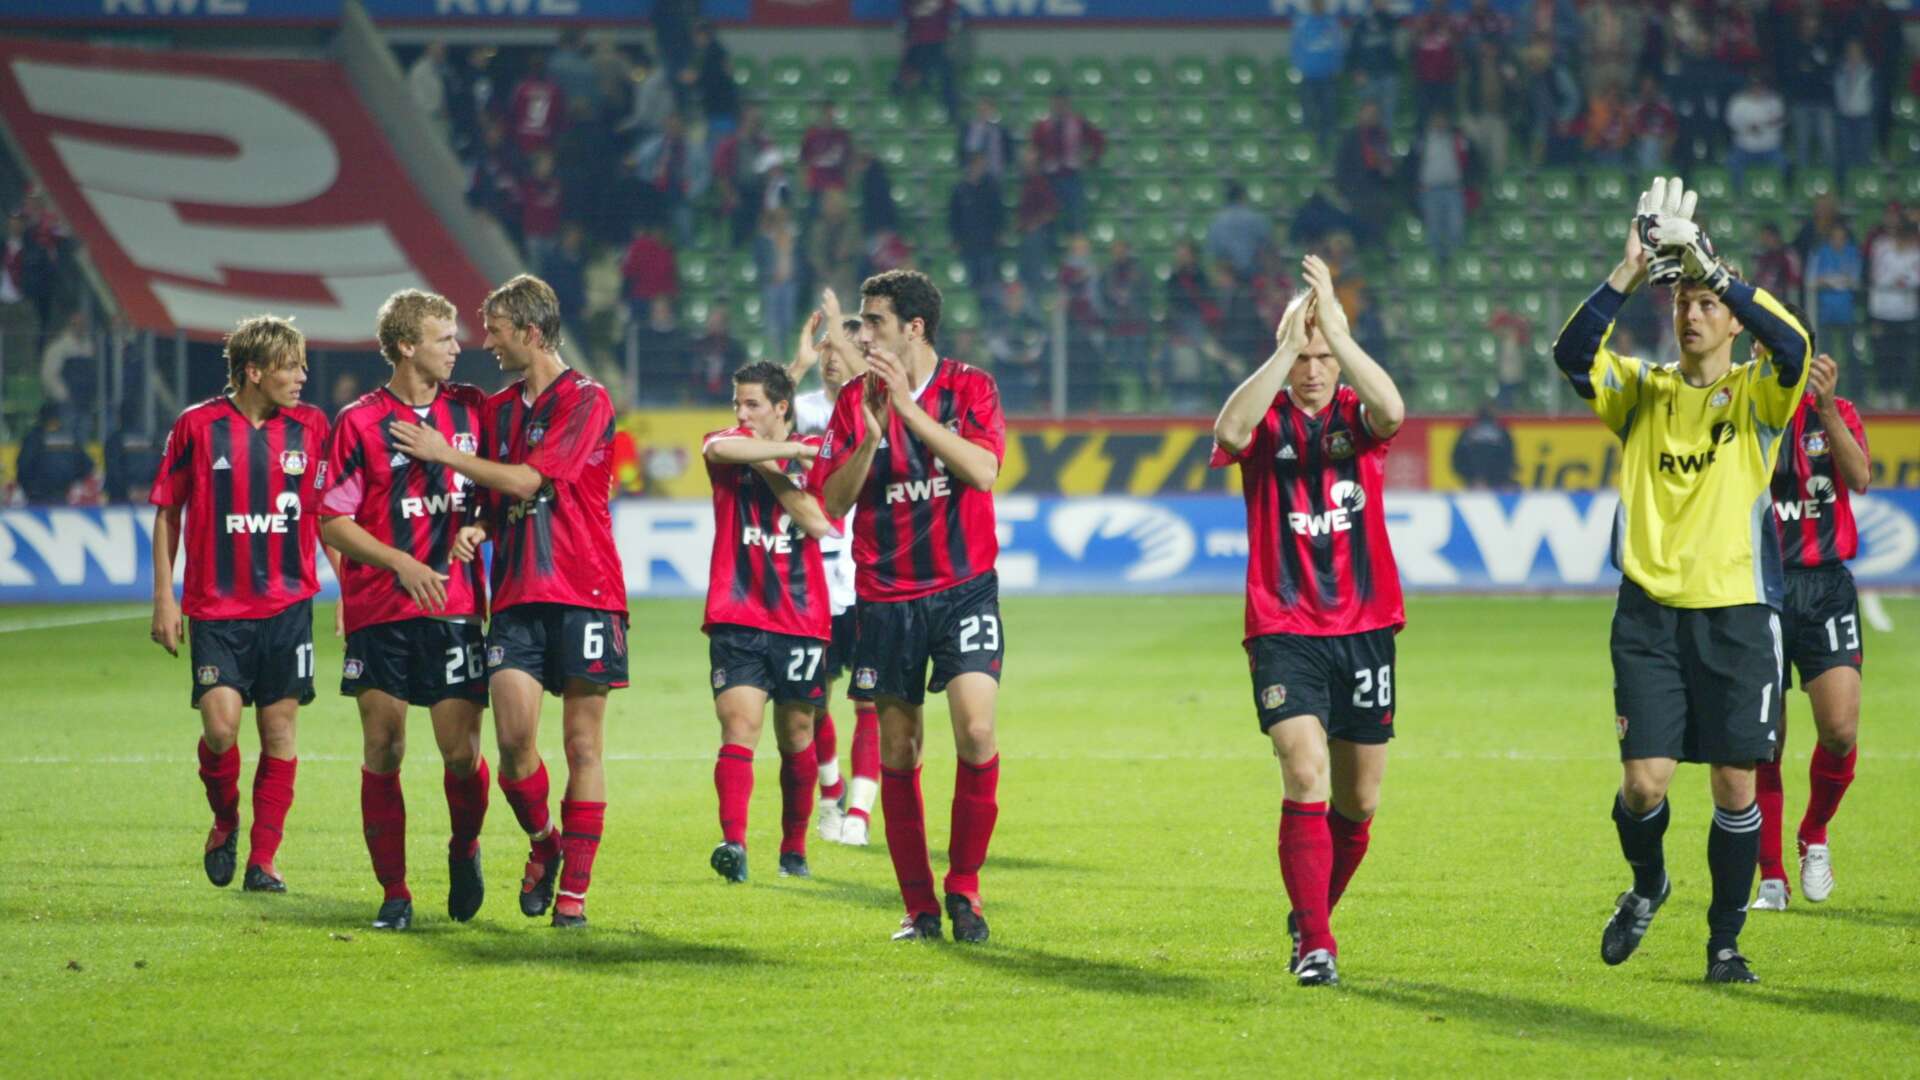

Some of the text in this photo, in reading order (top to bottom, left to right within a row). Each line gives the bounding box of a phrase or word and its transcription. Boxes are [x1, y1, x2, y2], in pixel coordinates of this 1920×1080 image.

[401, 492, 467, 519] RWE
[886, 476, 952, 504] RWE
[226, 514, 288, 534] RWE
[1288, 507, 1352, 537] RWE
[1774, 499, 1821, 521] WE
[1382, 493, 1621, 584] RW
[583, 622, 604, 659] 6
[960, 614, 999, 652] 23
[1825, 614, 1859, 652] 13
[446, 642, 484, 685] 26
[787, 647, 823, 681] 27
[1353, 665, 1391, 708] 28
[1760, 683, 1773, 723] 1
